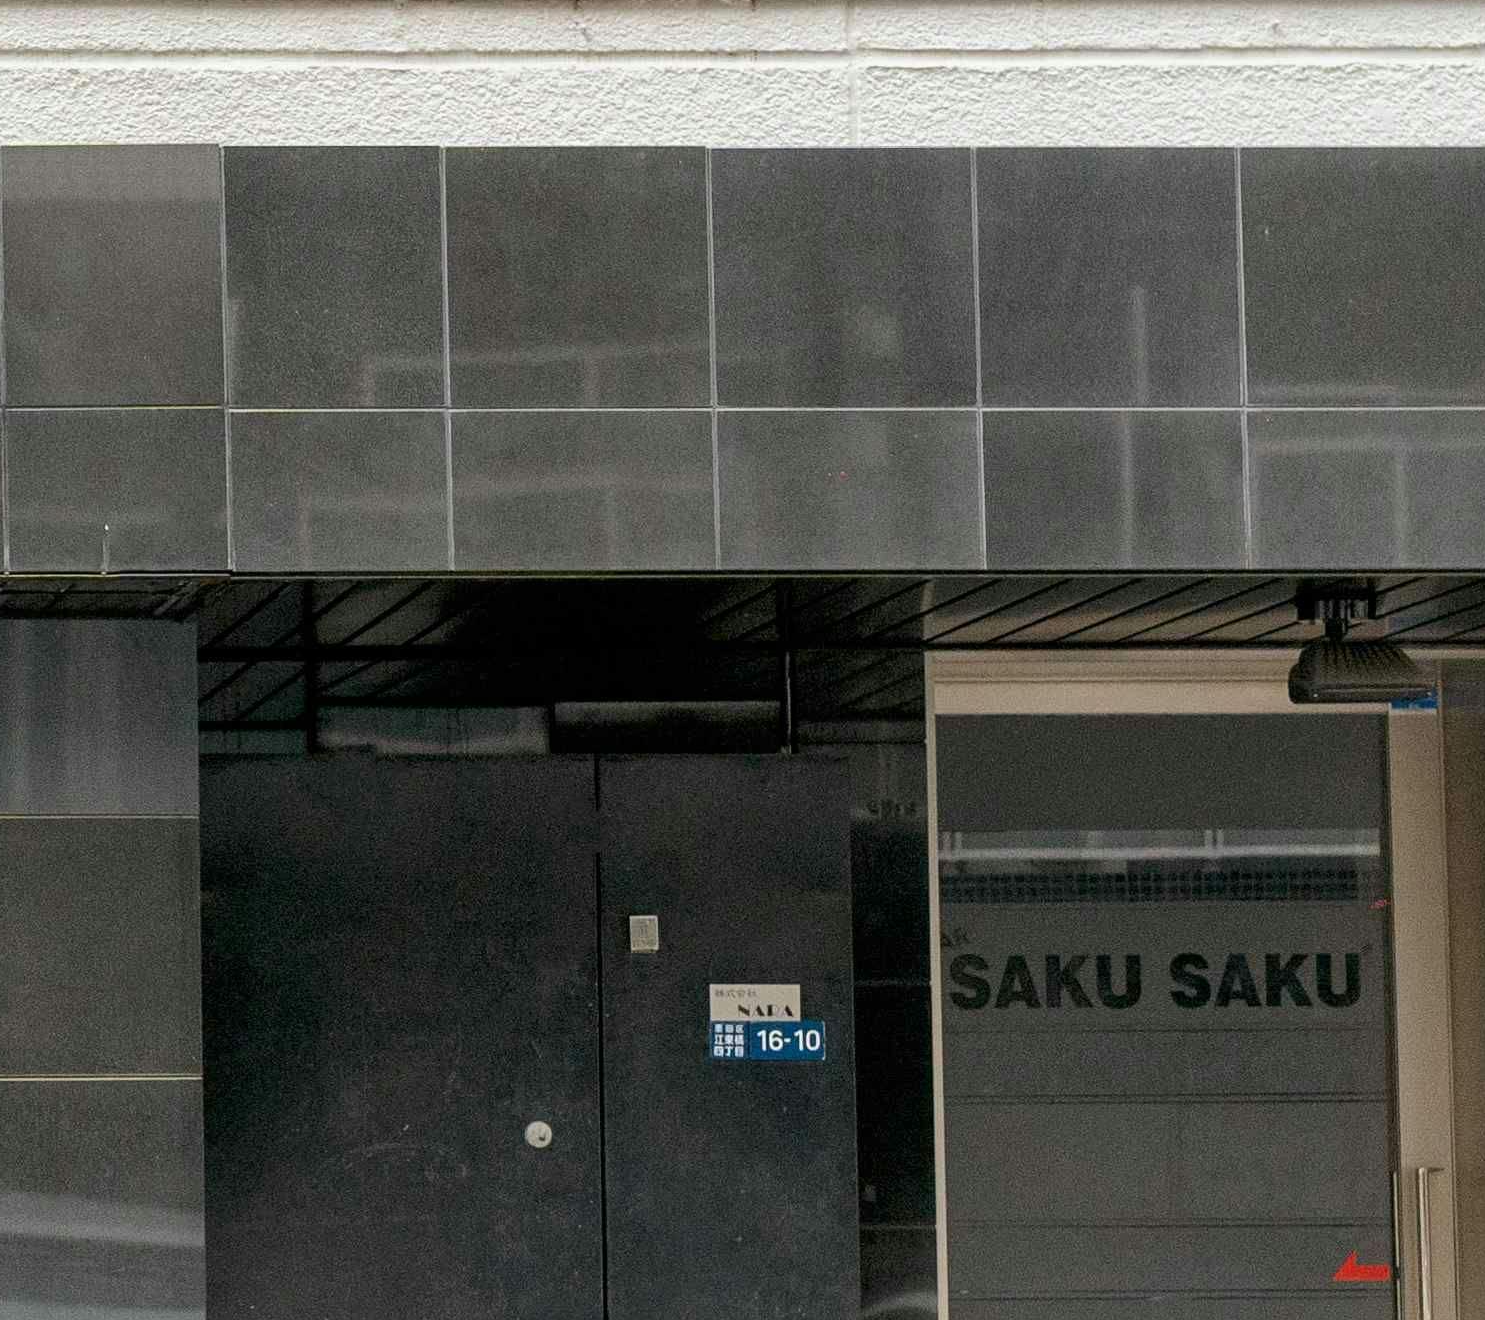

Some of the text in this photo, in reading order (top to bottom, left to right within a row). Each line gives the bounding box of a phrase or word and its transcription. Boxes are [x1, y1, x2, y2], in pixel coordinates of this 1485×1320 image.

[949, 952, 1361, 1010] SAKU SAKU
[738, 1004, 794, 1017] NARA
[757, 1029, 820, 1051] 16-10
